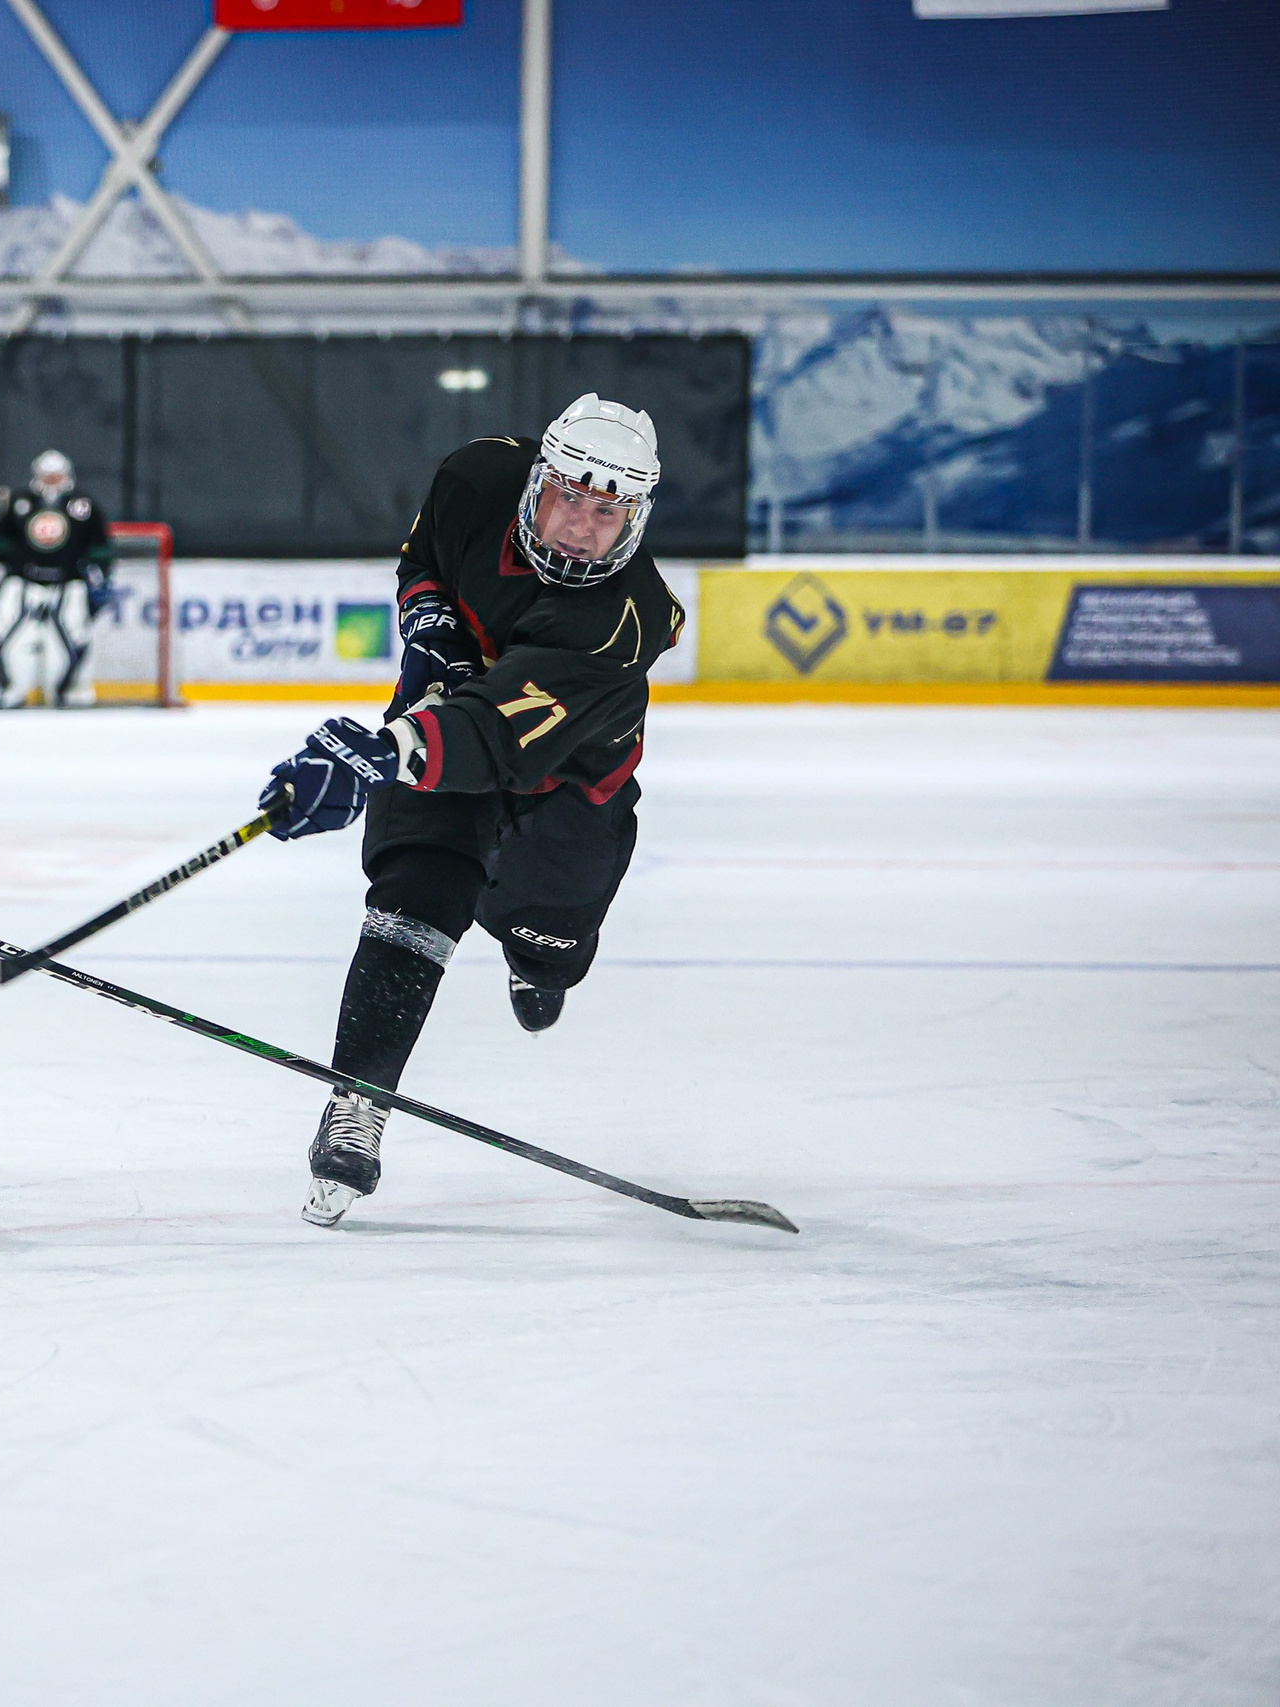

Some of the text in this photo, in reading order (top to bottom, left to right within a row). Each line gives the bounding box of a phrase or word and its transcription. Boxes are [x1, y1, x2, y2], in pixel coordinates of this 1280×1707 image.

[586, 456, 626, 473] BAUER
[496, 681, 568, 750] 71
[313, 724, 385, 784] BAUER
[519, 927, 571, 949] CCM
